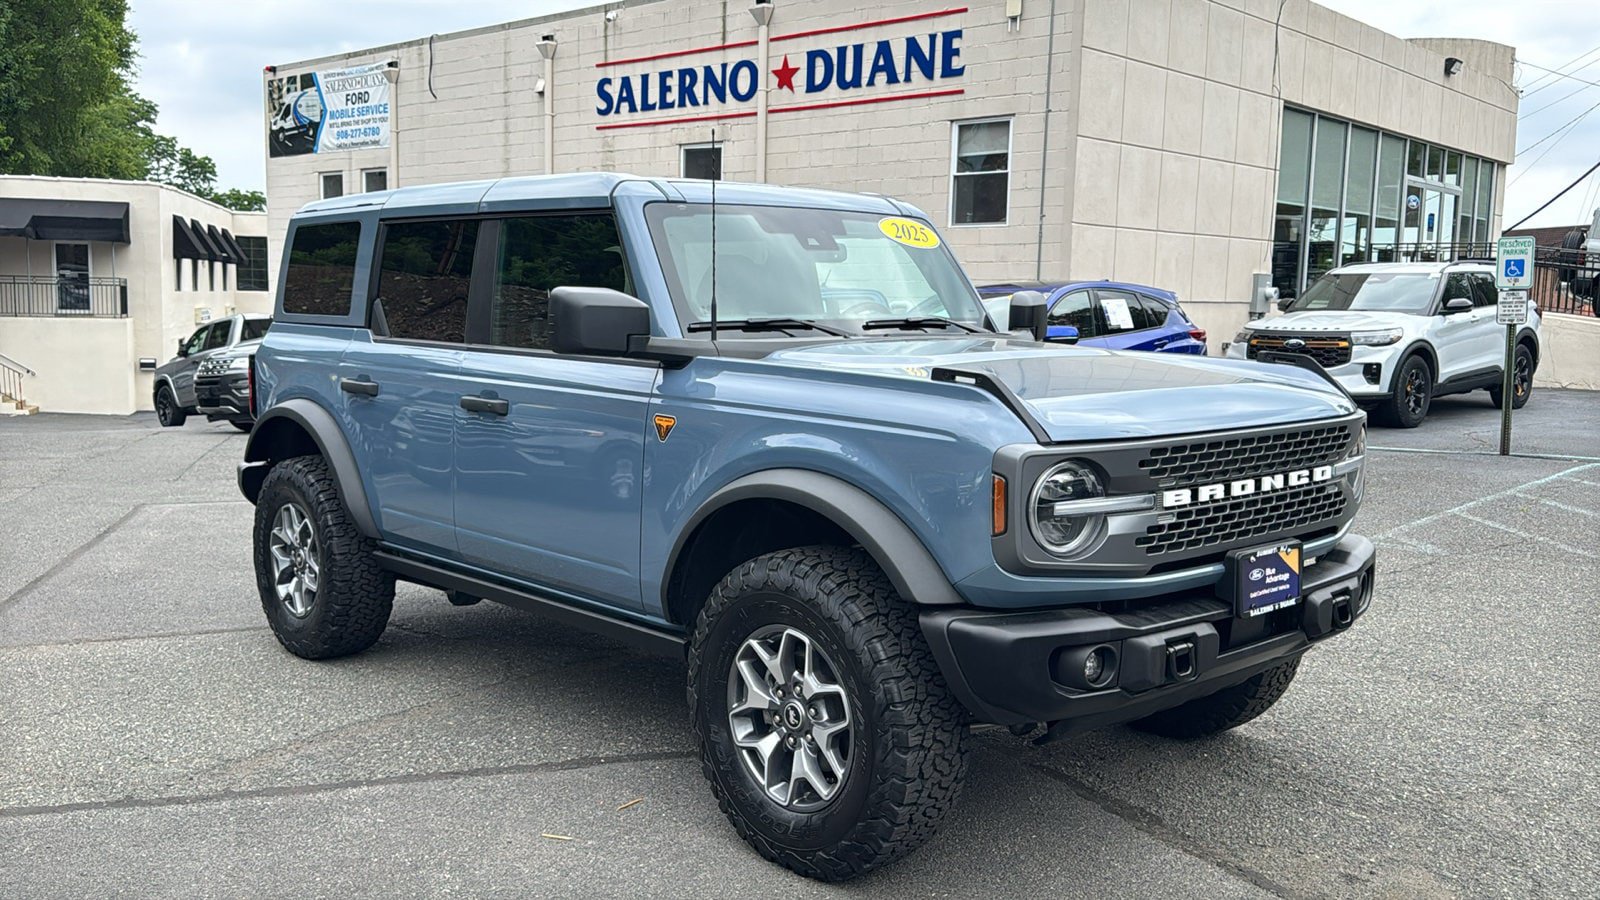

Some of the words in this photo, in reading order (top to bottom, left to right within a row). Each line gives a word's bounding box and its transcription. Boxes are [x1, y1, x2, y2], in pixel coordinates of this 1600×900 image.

[596, 59, 758, 116] SALERNO
[805, 29, 966, 94] DUANE
[346, 91, 370, 106] FORD
[329, 108, 356, 120] MOBILE
[356, 103, 389, 117] SERVICE
[336, 126, 380, 140] 908-277-6780
[891, 222, 929, 243] 2025
[1500, 240, 1532, 248] RESERVED
[1502, 248, 1528, 256] PARKING
[1163, 465, 1332, 508] BRONCO
